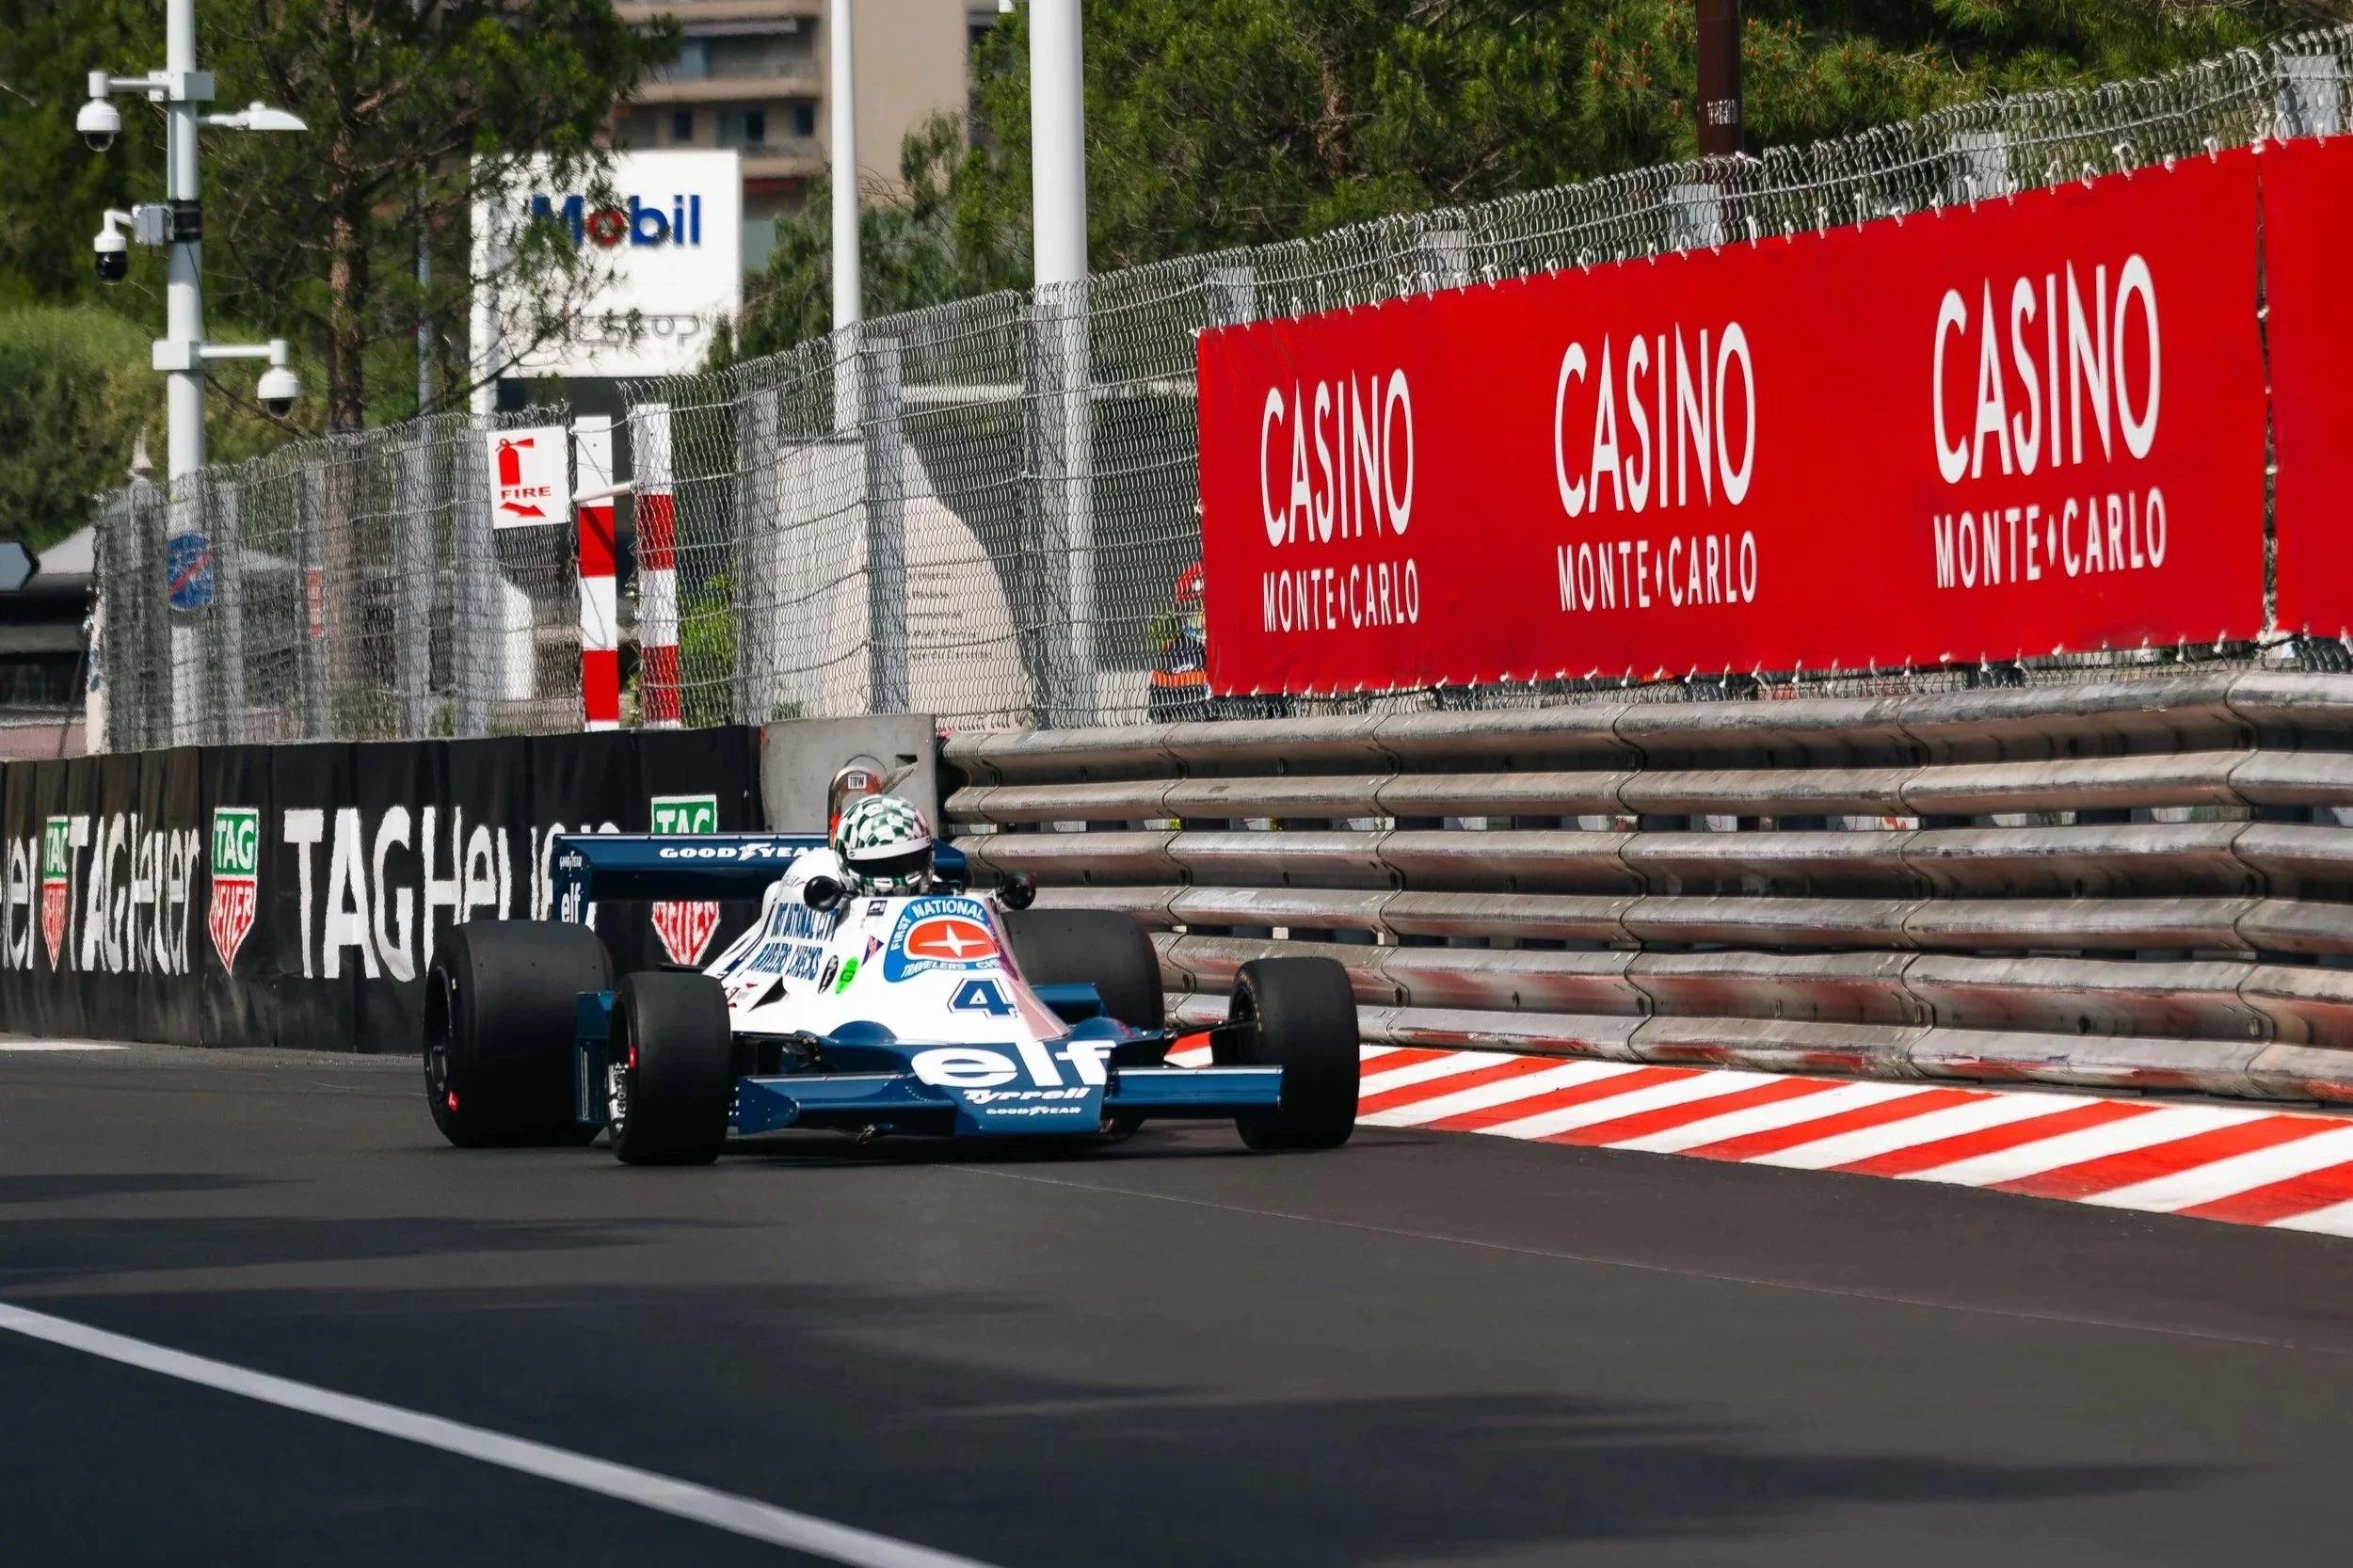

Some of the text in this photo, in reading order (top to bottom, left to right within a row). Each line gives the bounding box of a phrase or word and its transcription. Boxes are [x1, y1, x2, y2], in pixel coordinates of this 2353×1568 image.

[531, 194, 701, 248] Mobil
[1933, 254, 2161, 485] CASINO
[1554, 321, 1756, 518] CASINO
[1261, 368, 1414, 547] CASINO
[500, 486, 552, 501] FIRE
[849, 776, 865, 789] TOW
[216, 819, 255, 870] TAG
[561, 882, 582, 924] elf
[890, 915, 913, 952] FIRST
[911, 900, 984, 921] NATIONAL
[901, 960, 968, 979] TRAVELERS
[947, 977, 1017, 1018] 4
[911, 1039, 1116, 1088] elf
[963, 1087, 1092, 1104] Tyrrell
[985, 1105, 1081, 1116] GOODYEAR
